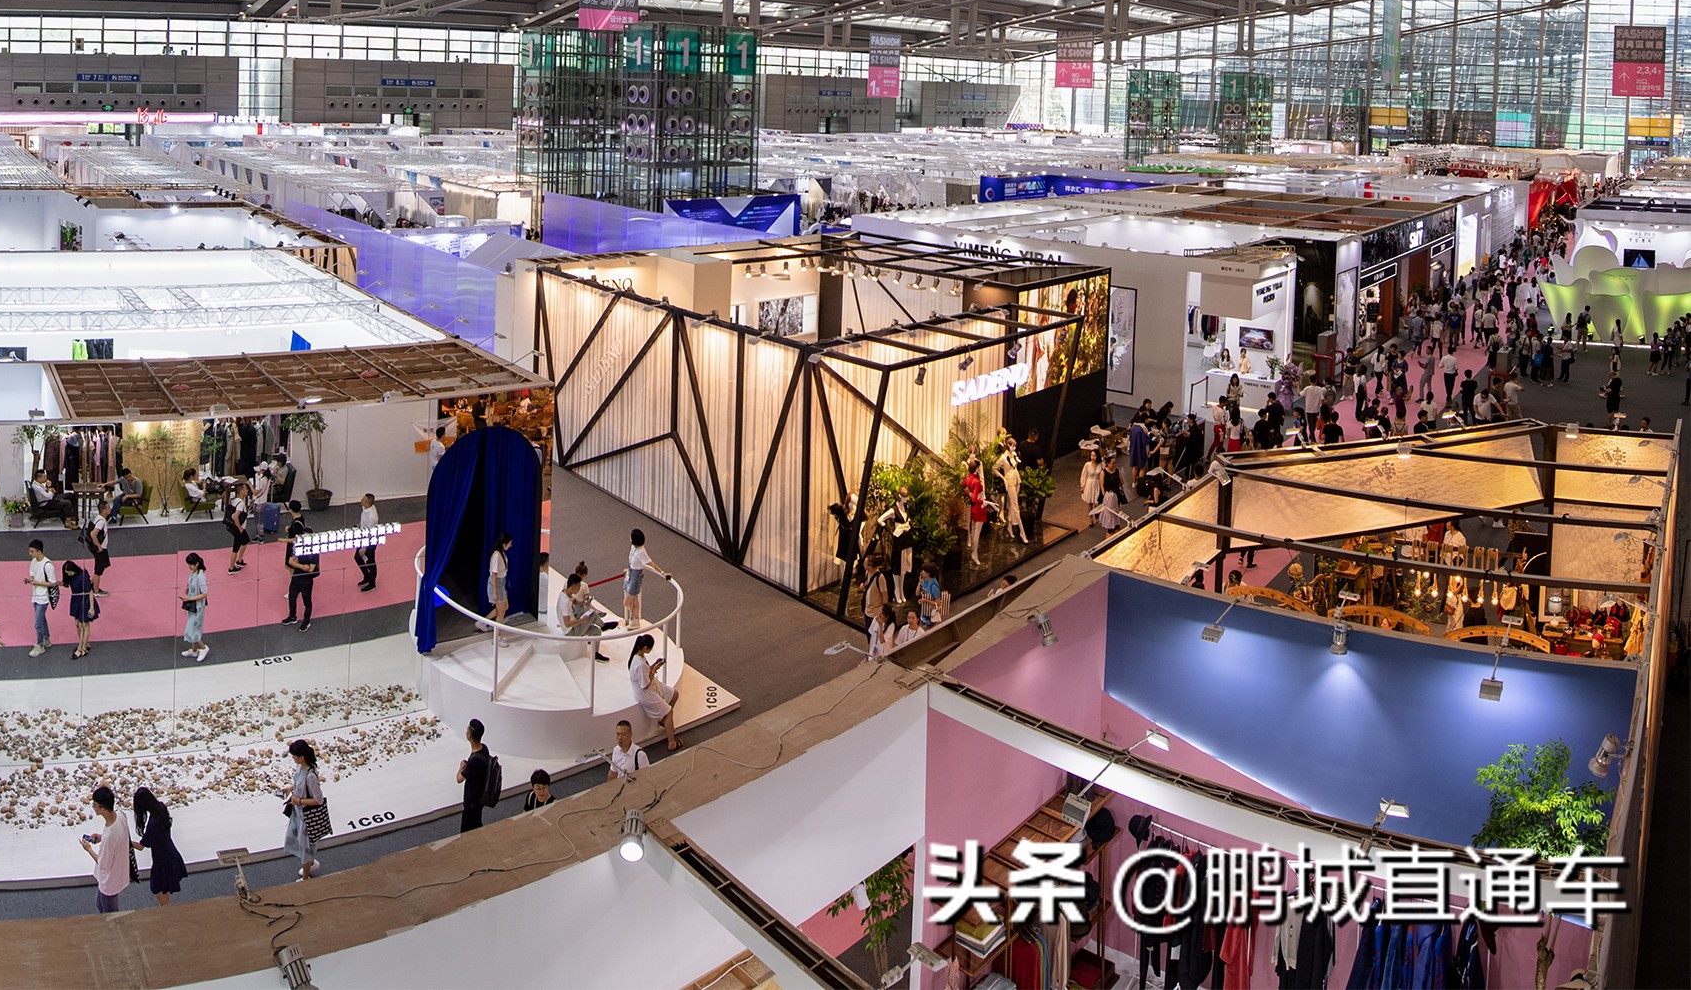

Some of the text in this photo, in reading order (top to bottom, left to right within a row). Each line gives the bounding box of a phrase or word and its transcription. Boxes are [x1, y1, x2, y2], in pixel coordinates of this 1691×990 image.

[870, 35, 901, 47] FASHION
[1616, 29, 1664, 40] FASHION
[634, 36, 643, 66] 1
[679, 38, 690, 67] 1
[736, 41, 748, 70] 1
[1068, 48, 1092, 58] SHOW
[1630, 50, 1663, 60] SHOW
[1230, 78, 1237, 94] 1
[953, 241, 1011, 261] YIMENG
[584, 338, 623, 396] SADENO
[950, 362, 1029, 407] SADENO
[705, 685, 718, 709] 1C60
[346, 810, 397, 831] 1C60
